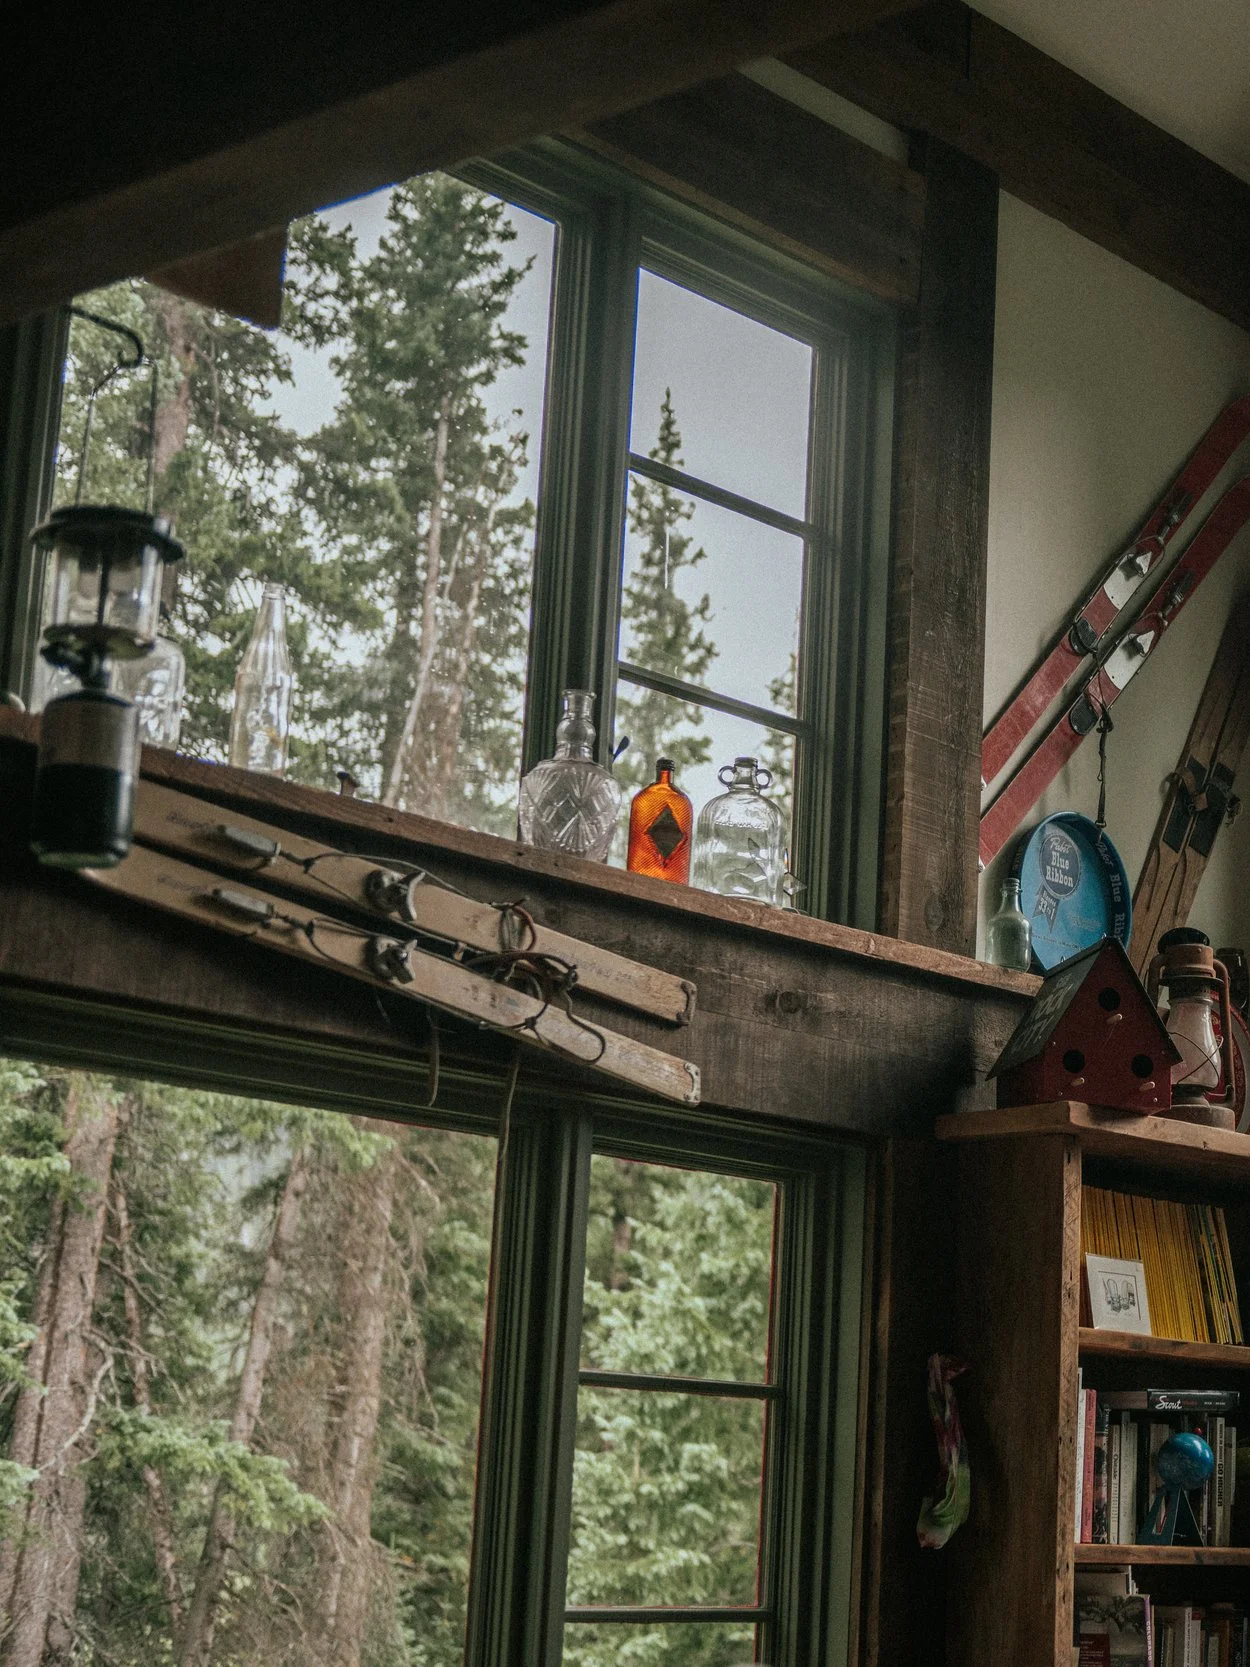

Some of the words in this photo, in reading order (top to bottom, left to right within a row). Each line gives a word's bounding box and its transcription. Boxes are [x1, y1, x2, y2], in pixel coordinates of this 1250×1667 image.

[1050, 837, 1072, 854] Pabst
[1095, 840, 1114, 867] Pabst
[1051, 850, 1069, 870] Blue
[1046, 866, 1074, 888] Ribbon
[1109, 873, 1122, 903] Blue
[1039, 897, 1048, 913] 33
[1113, 912, 1125, 938] Rib
[1155, 1395, 1183, 1410] Scout
[1217, 1463, 1224, 1475] GO
